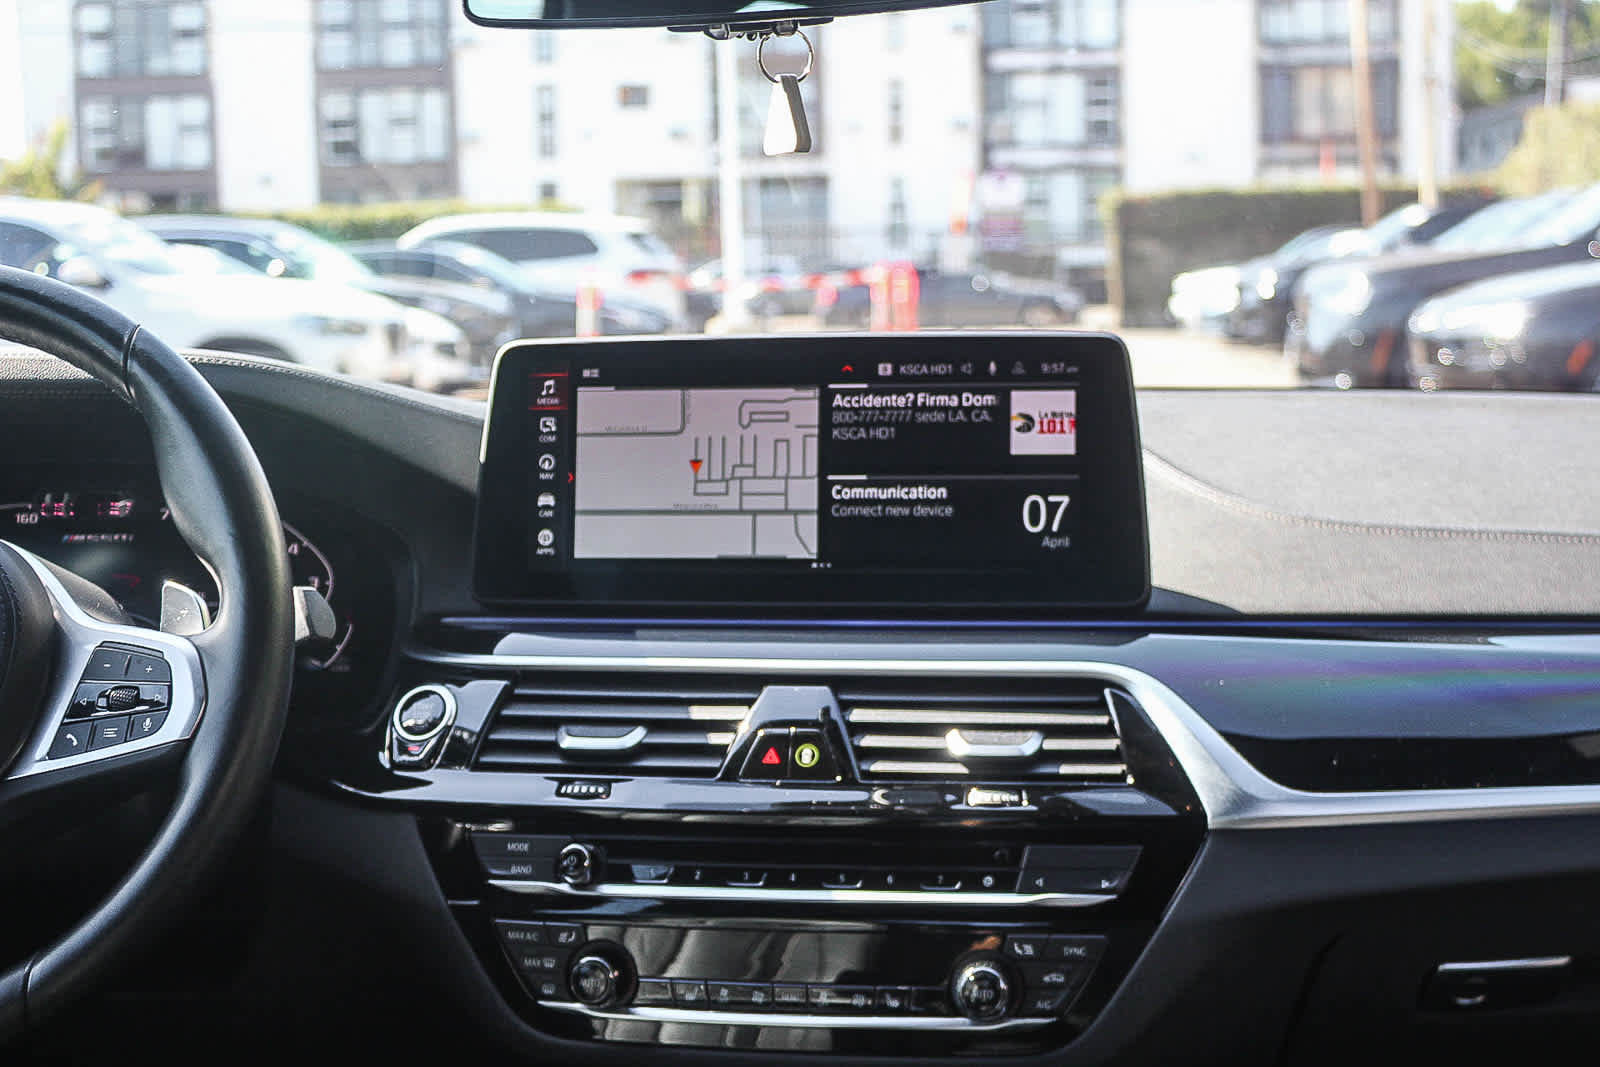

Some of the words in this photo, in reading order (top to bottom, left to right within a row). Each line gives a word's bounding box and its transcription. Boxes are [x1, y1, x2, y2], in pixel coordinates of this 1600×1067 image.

[900, 364, 930, 376] KSCA
[933, 363, 952, 375] HD1
[537, 397, 559, 406] MEDIA
[832, 392, 915, 408] Accidente?
[917, 392, 960, 407] Firma
[832, 409, 912, 424] 800-777-7777
[914, 409, 946, 423] sede
[832, 426, 867, 440] KSCA
[869, 425, 896, 440] HD1
[539, 472, 554, 481] NAV
[831, 484, 947, 500] Communication
[538, 508, 553, 518] CAR
[831, 504, 883, 517] Connect
[885, 505, 911, 517] new
[912, 504, 954, 517] device
[1022, 494, 1071, 533] 07
[15, 512, 39, 524] 160
[287, 543, 299, 556] 4
[1041, 535, 1071, 551] April
[536, 547, 555, 556] APPS
[507, 842, 529, 852] MODE
[510, 864, 533, 874] BAND
